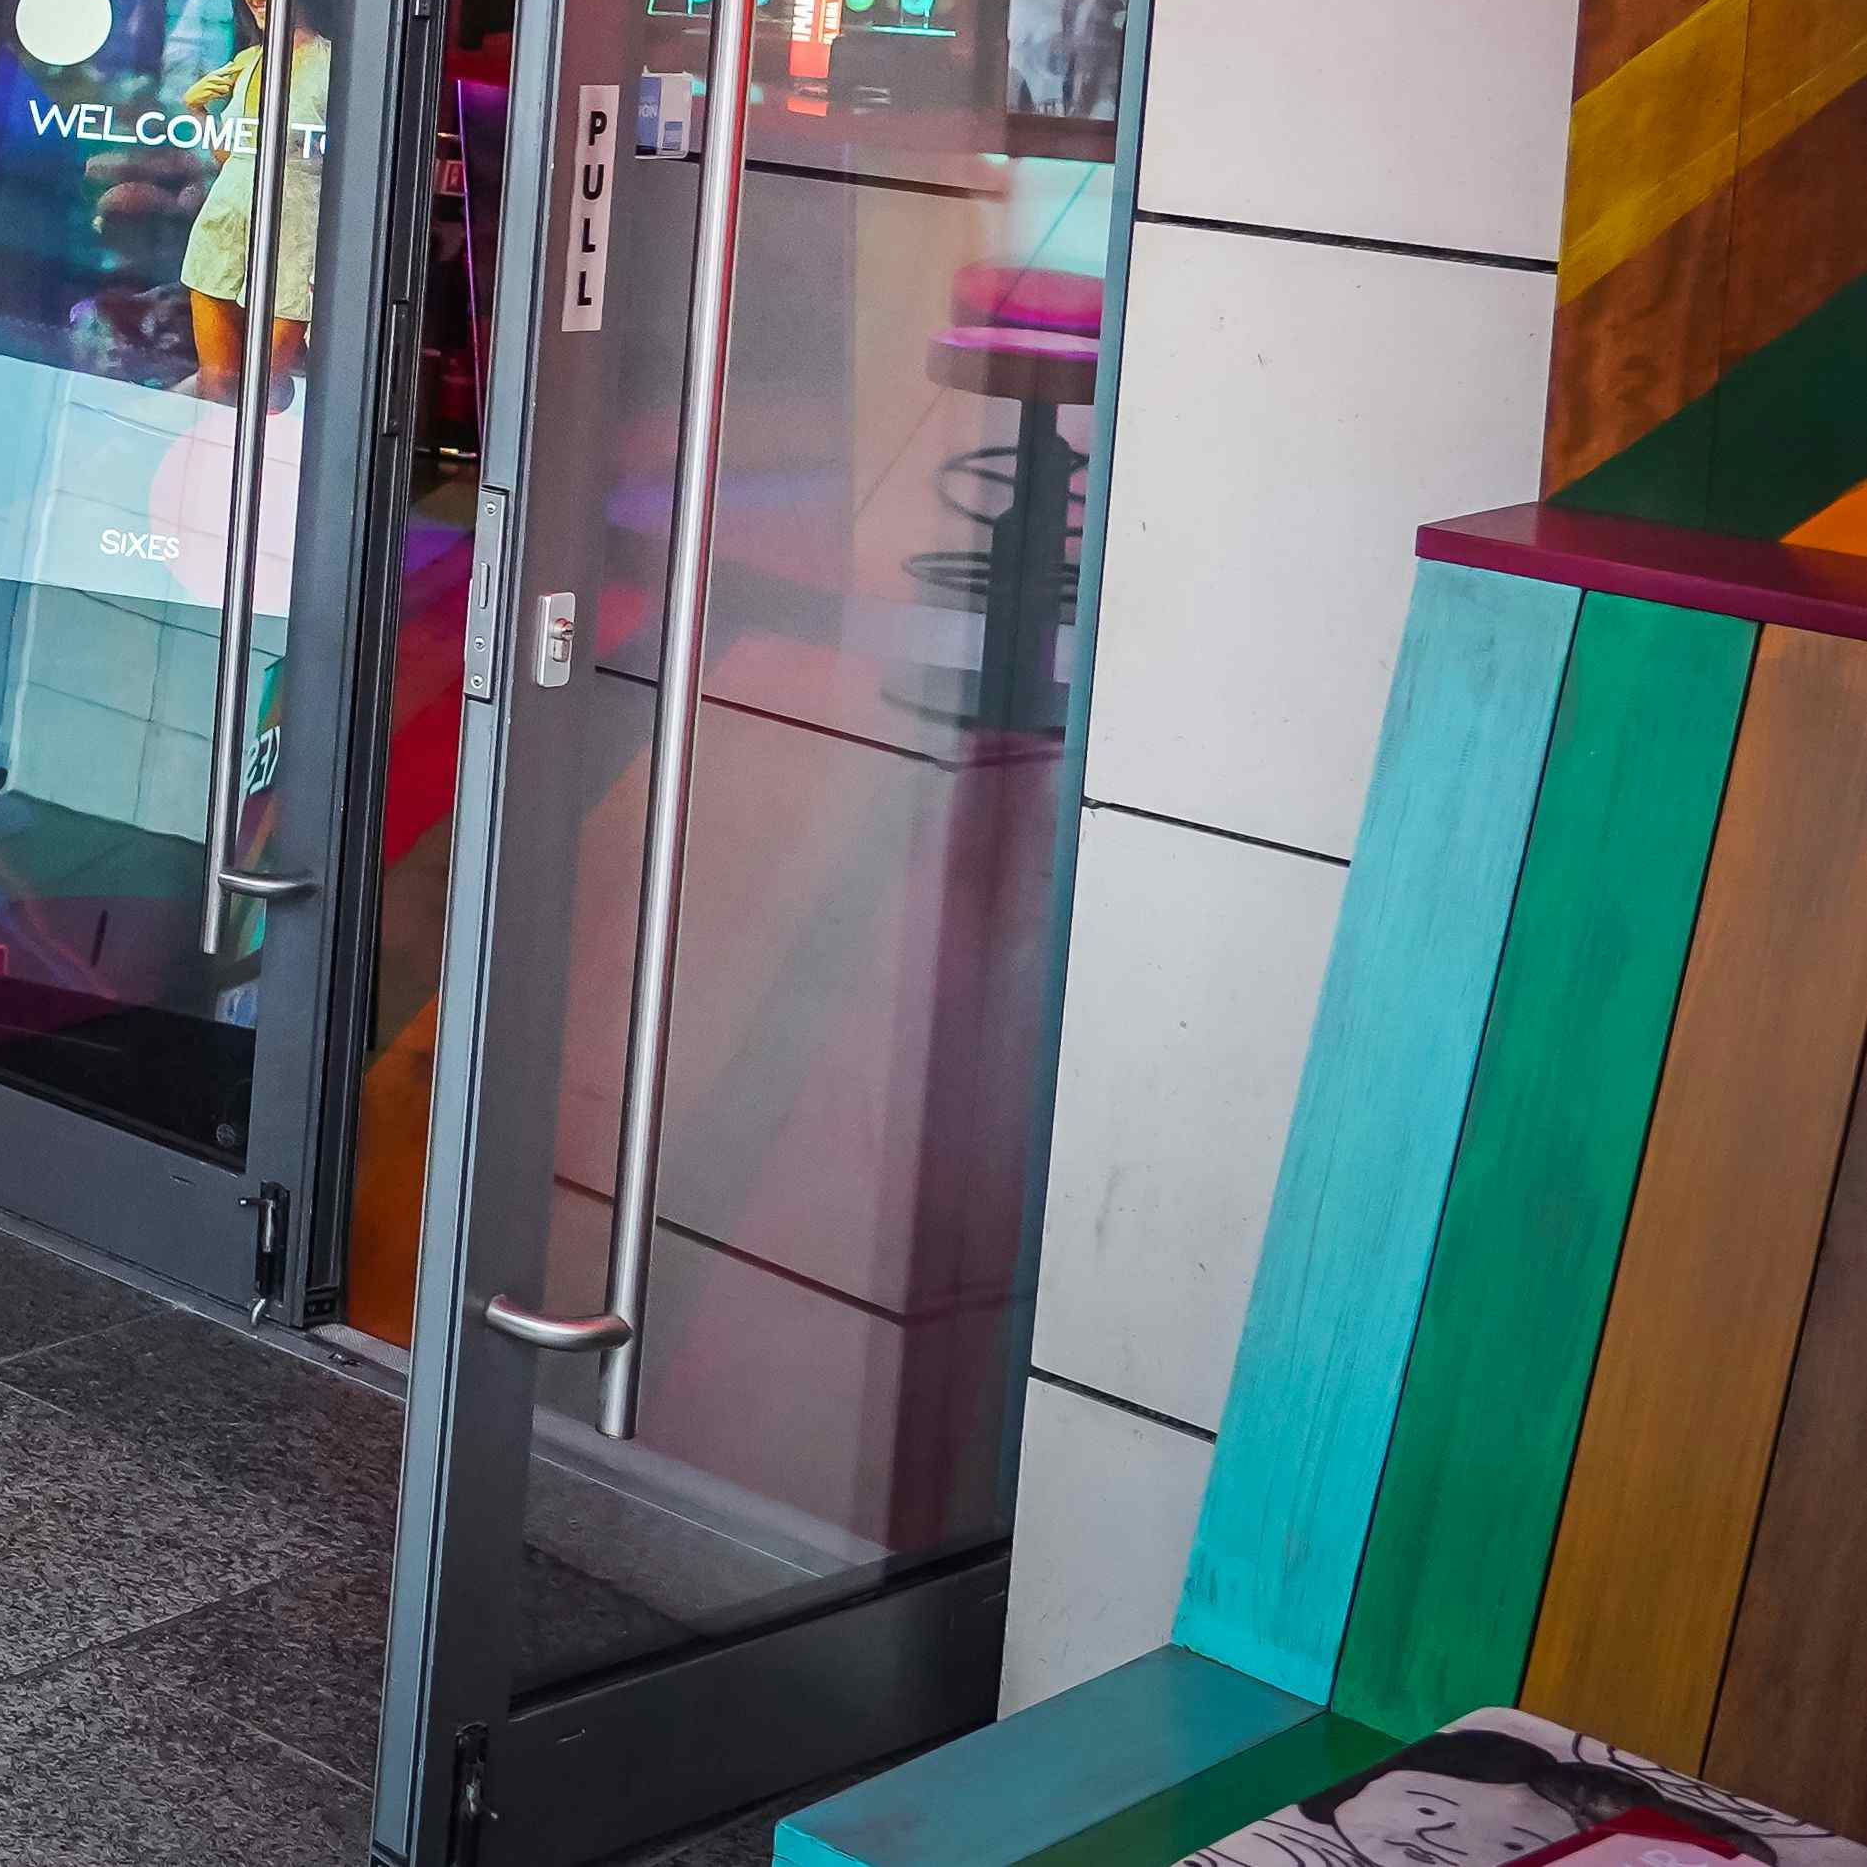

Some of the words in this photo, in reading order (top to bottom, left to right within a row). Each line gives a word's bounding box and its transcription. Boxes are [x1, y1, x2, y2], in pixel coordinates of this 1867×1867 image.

[29, 99, 259, 154] WELCOME
[291, 123, 327, 159] T
[577, 111, 608, 306] PULL
[99, 529, 180, 561] SIXES
